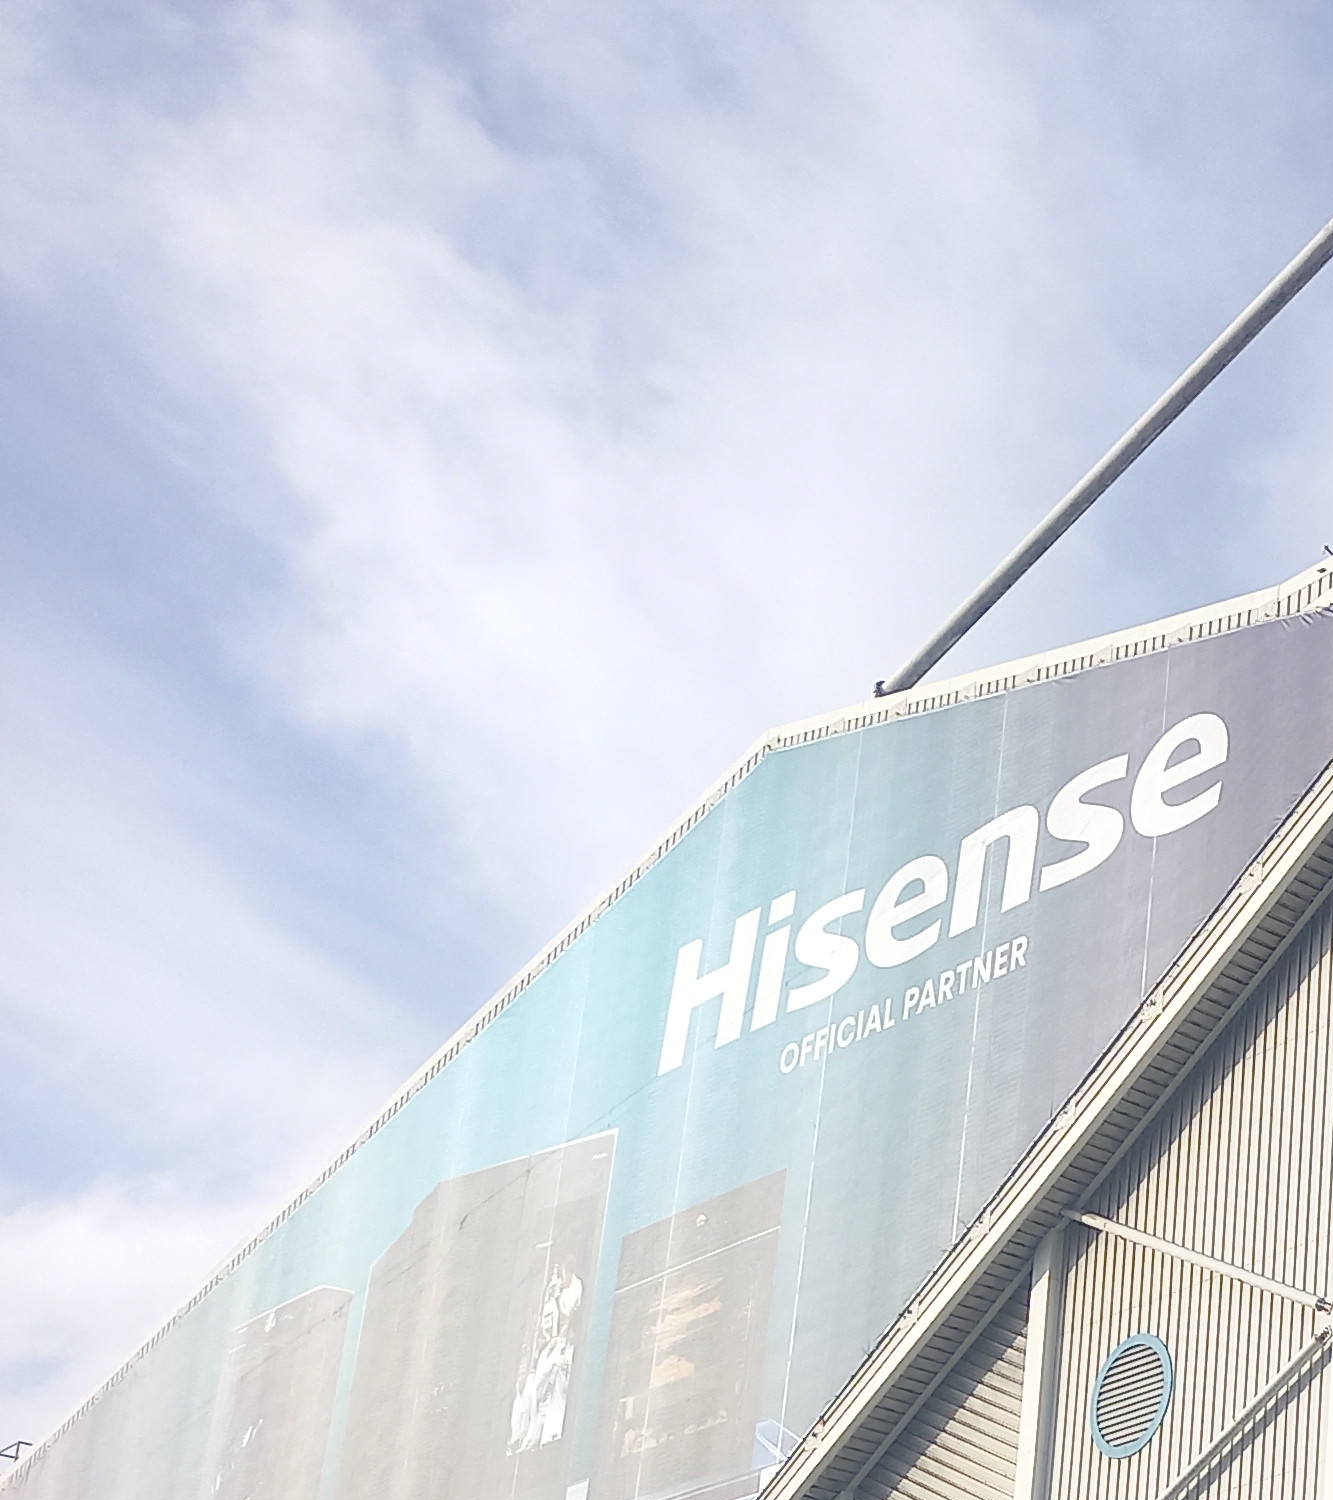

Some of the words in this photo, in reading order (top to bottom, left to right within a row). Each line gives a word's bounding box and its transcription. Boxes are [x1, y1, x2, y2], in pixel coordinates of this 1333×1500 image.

[658, 713, 1229, 1077] Hisense
[780, 1000, 896, 1075] OFFICIAL
[902, 935, 1029, 1021] PARTNER
